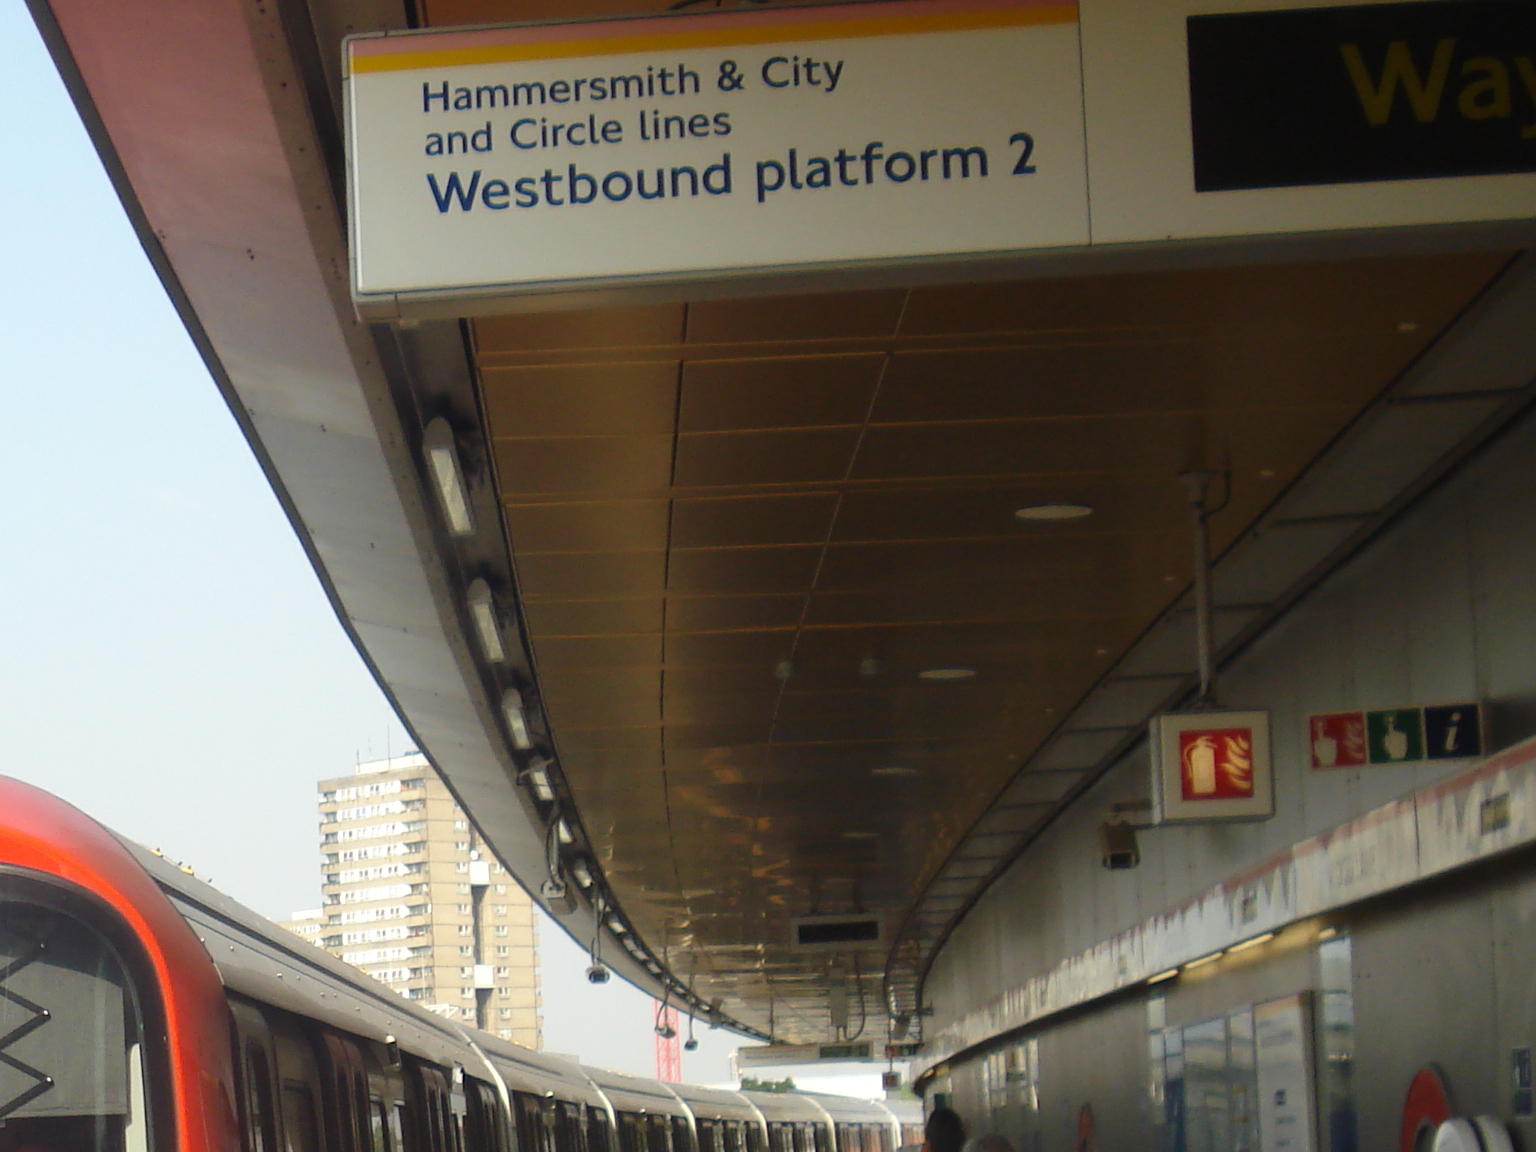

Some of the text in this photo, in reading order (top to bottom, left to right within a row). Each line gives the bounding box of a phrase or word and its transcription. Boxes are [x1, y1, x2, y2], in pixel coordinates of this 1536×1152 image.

[422, 55, 844, 113] Hammersmith & City
[424, 109, 733, 156] and Circle lines
[426, 132, 1037, 214] Westbound platform 2
